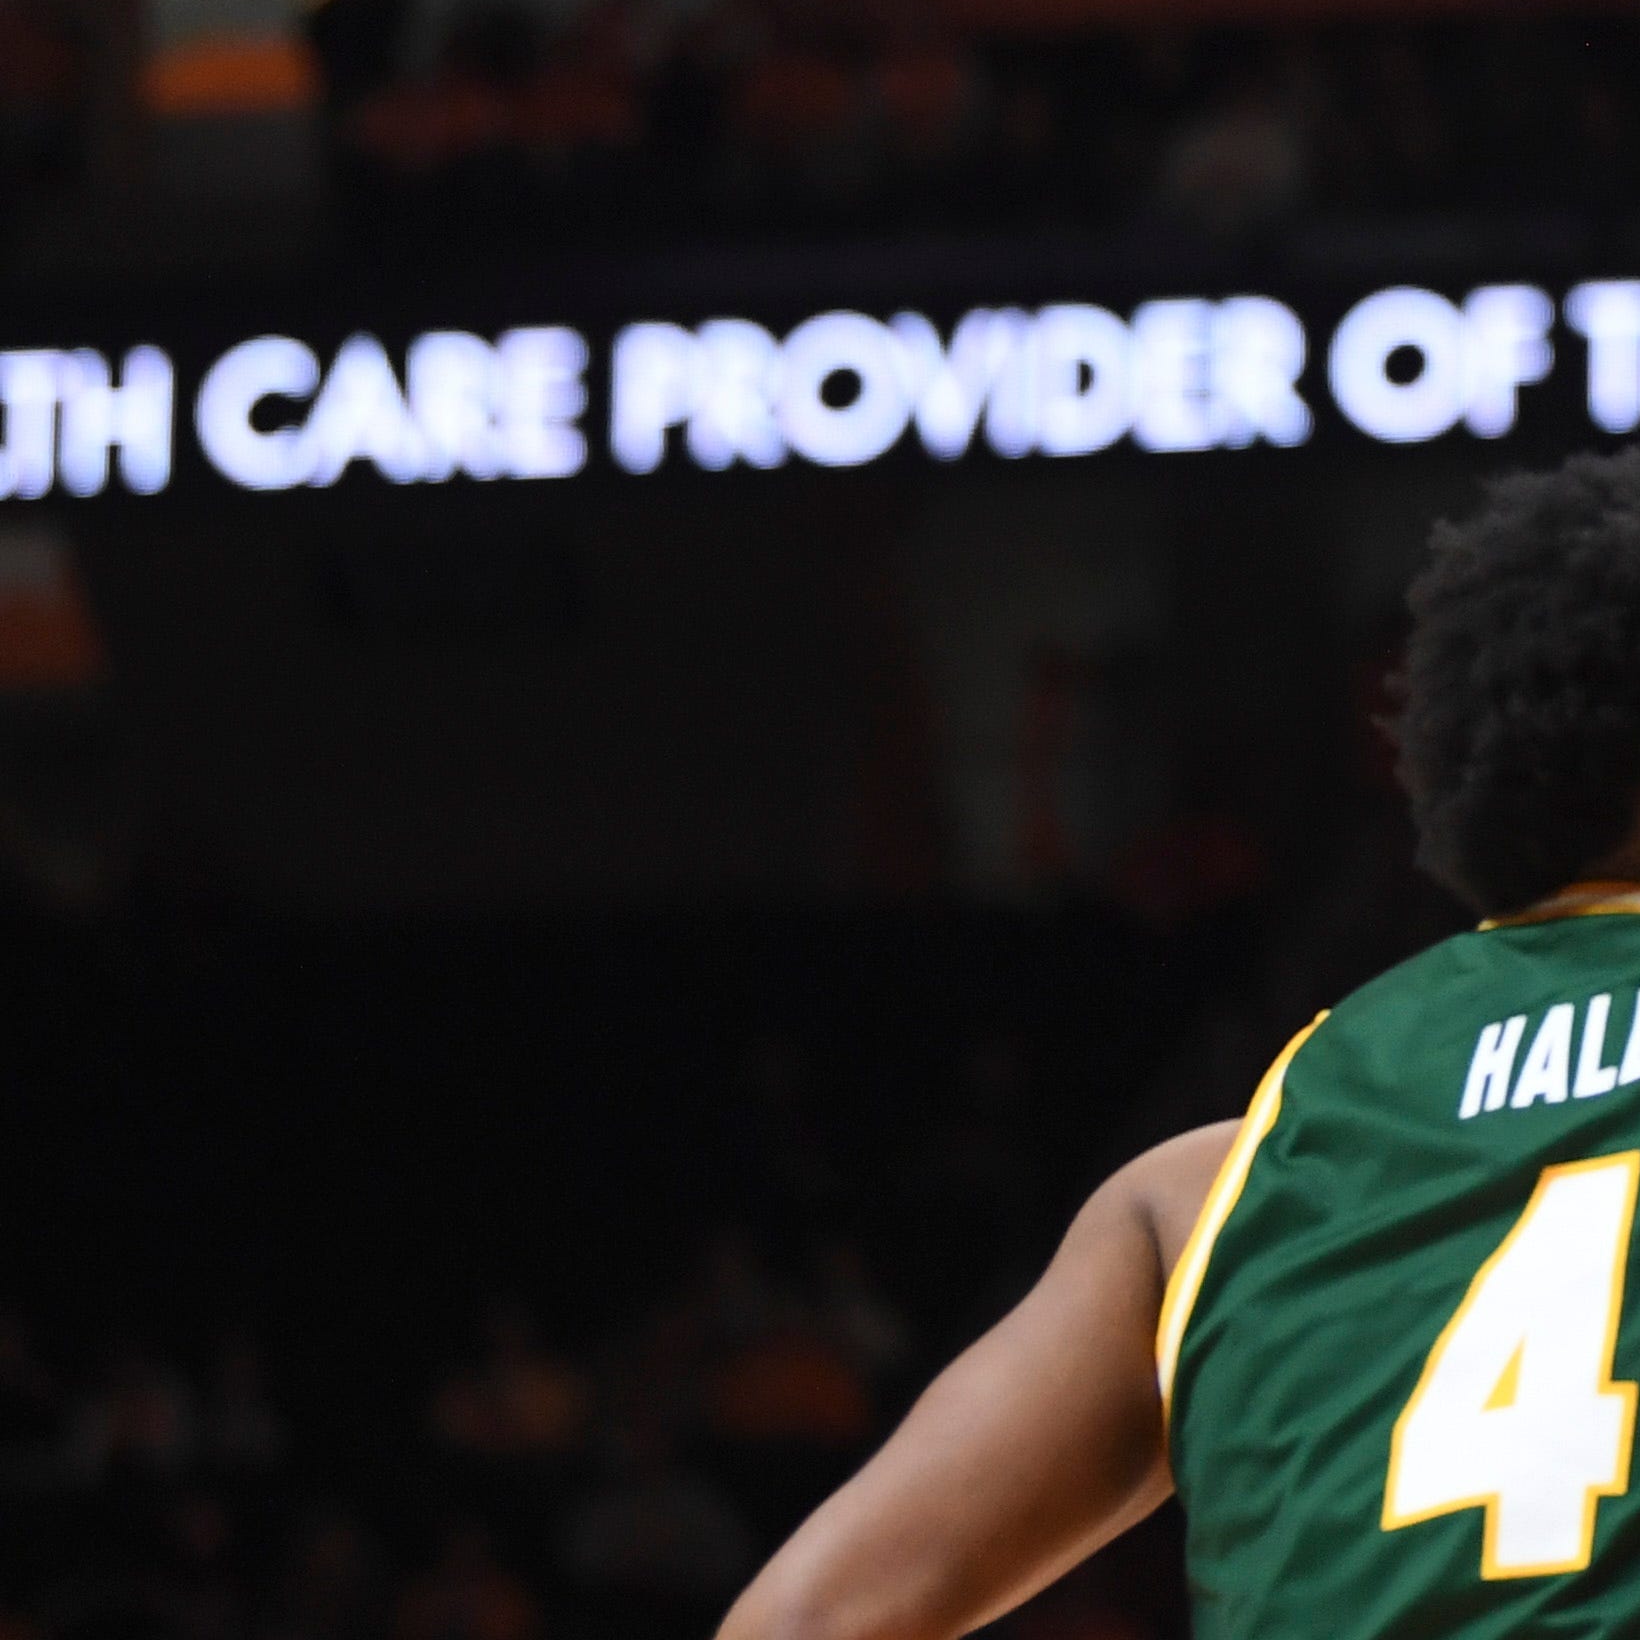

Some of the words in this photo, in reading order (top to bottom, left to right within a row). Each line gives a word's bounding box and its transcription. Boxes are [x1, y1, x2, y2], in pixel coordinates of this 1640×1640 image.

[0, 345, 174, 501] TH
[196, 325, 588, 491] CARE
[610, 293, 1313, 476] PROVIDER
[1328, 282, 1554, 443] OF
